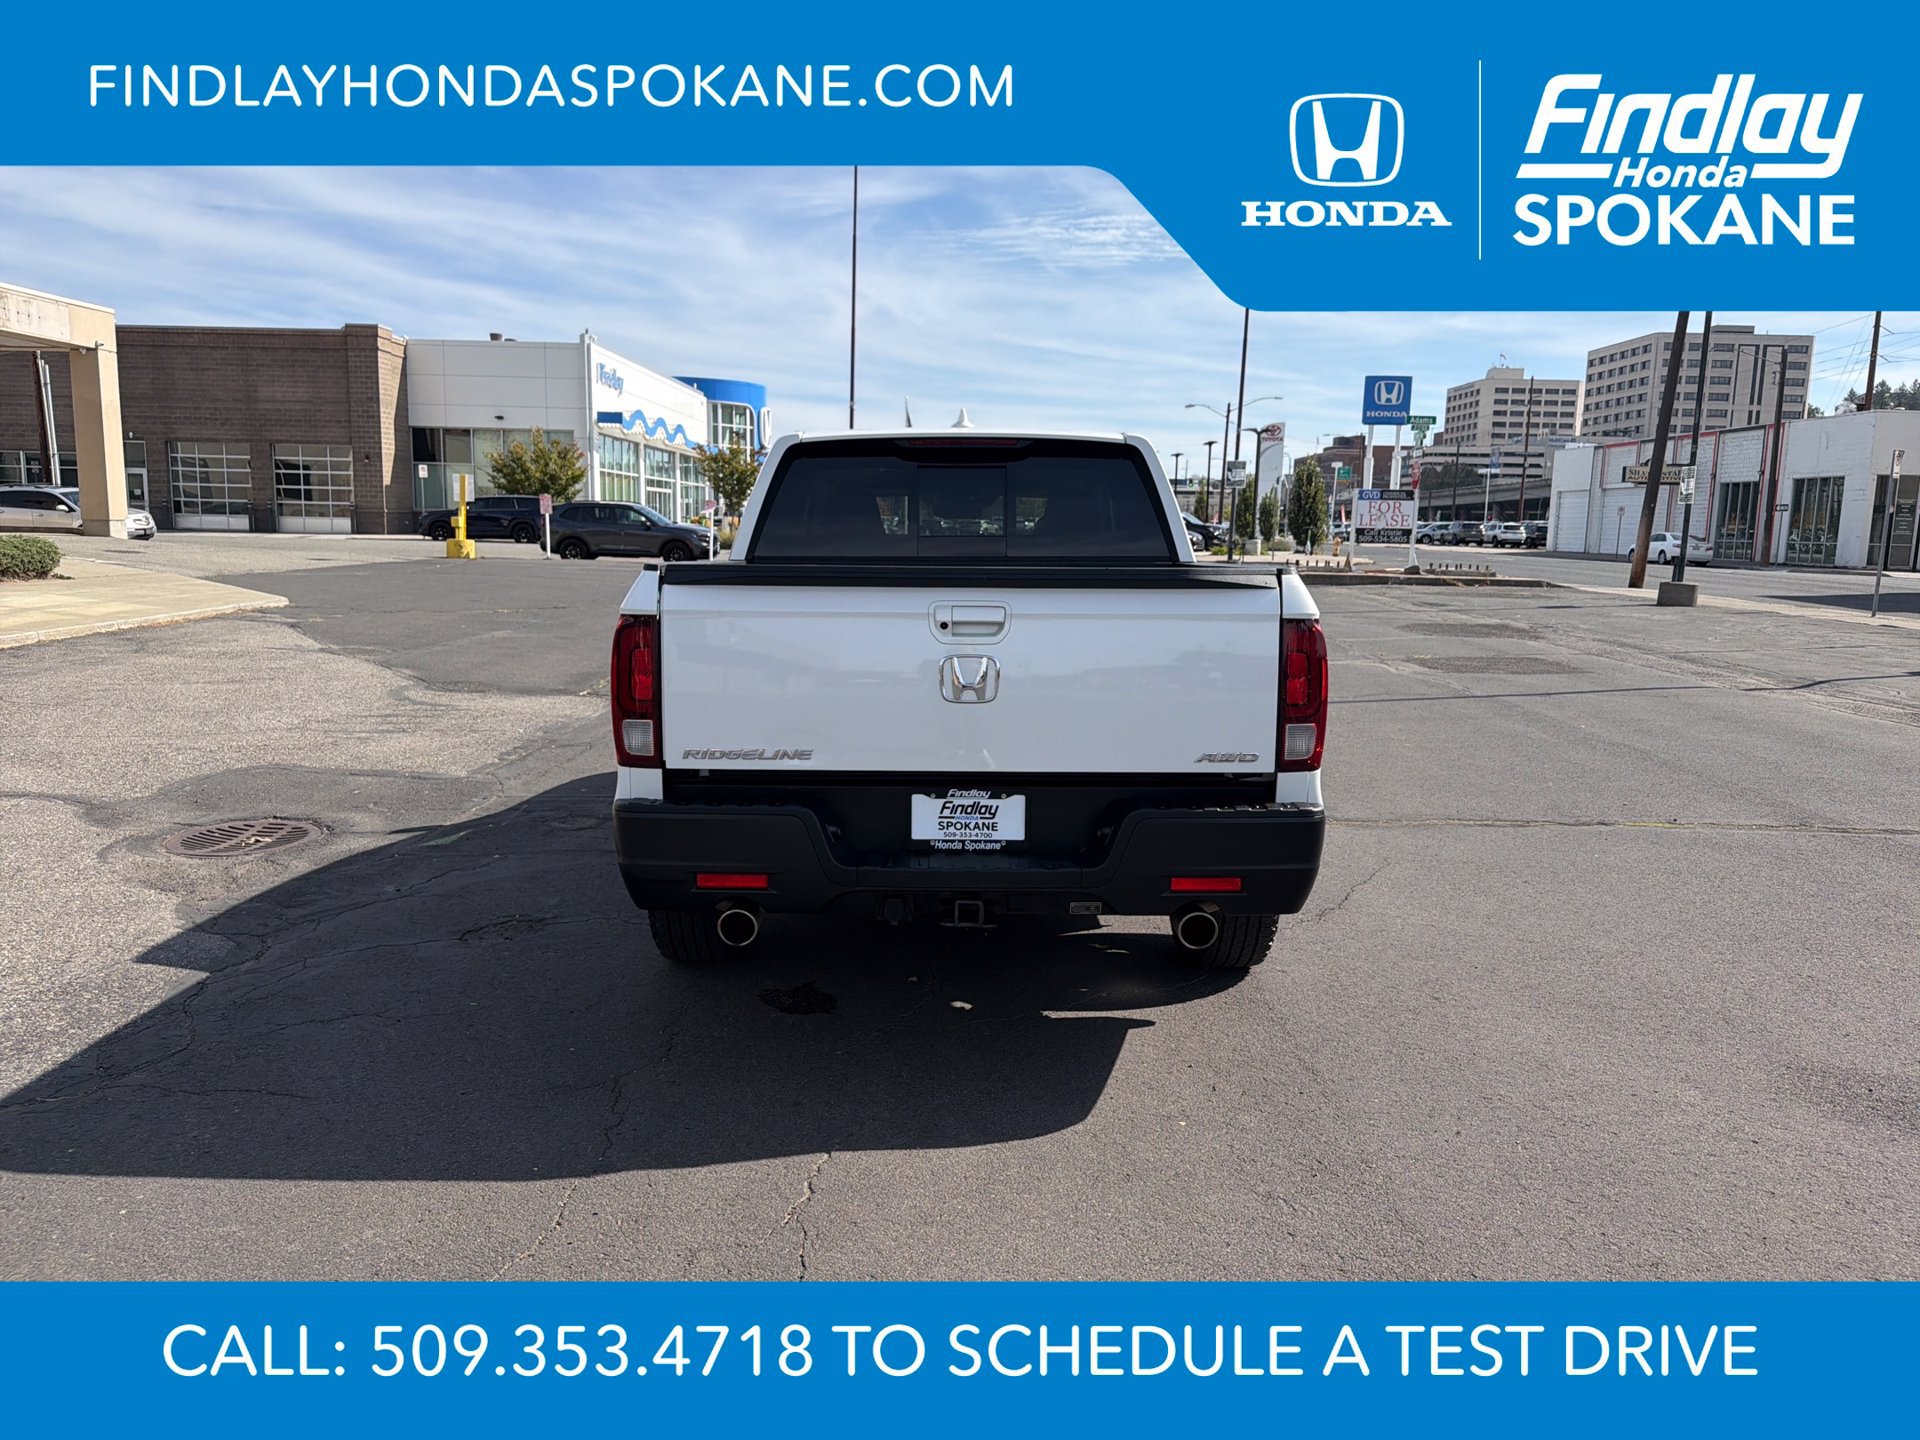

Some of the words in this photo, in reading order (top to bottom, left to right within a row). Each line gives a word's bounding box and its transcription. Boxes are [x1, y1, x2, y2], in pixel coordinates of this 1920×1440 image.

[1366, 410, 1407, 418] HONDA
[1410, 416, 1433, 424] Adams
[1362, 491, 1380, 500] GVD
[1368, 501, 1403, 514] FOR
[1359, 514, 1410, 527] LEASE
[1364, 528, 1378, 536] Call
[682, 748, 814, 761] RIDGELINE
[1193, 752, 1260, 763] AWD
[947, 788, 992, 799] Findlay
[938, 800, 1000, 820] Findlay
[938, 821, 998, 832] SPOKANE
[943, 831, 993, 839] 509-353-4700
[935, 840, 962, 850] Honda
[964, 840, 1001, 851] Spokane
